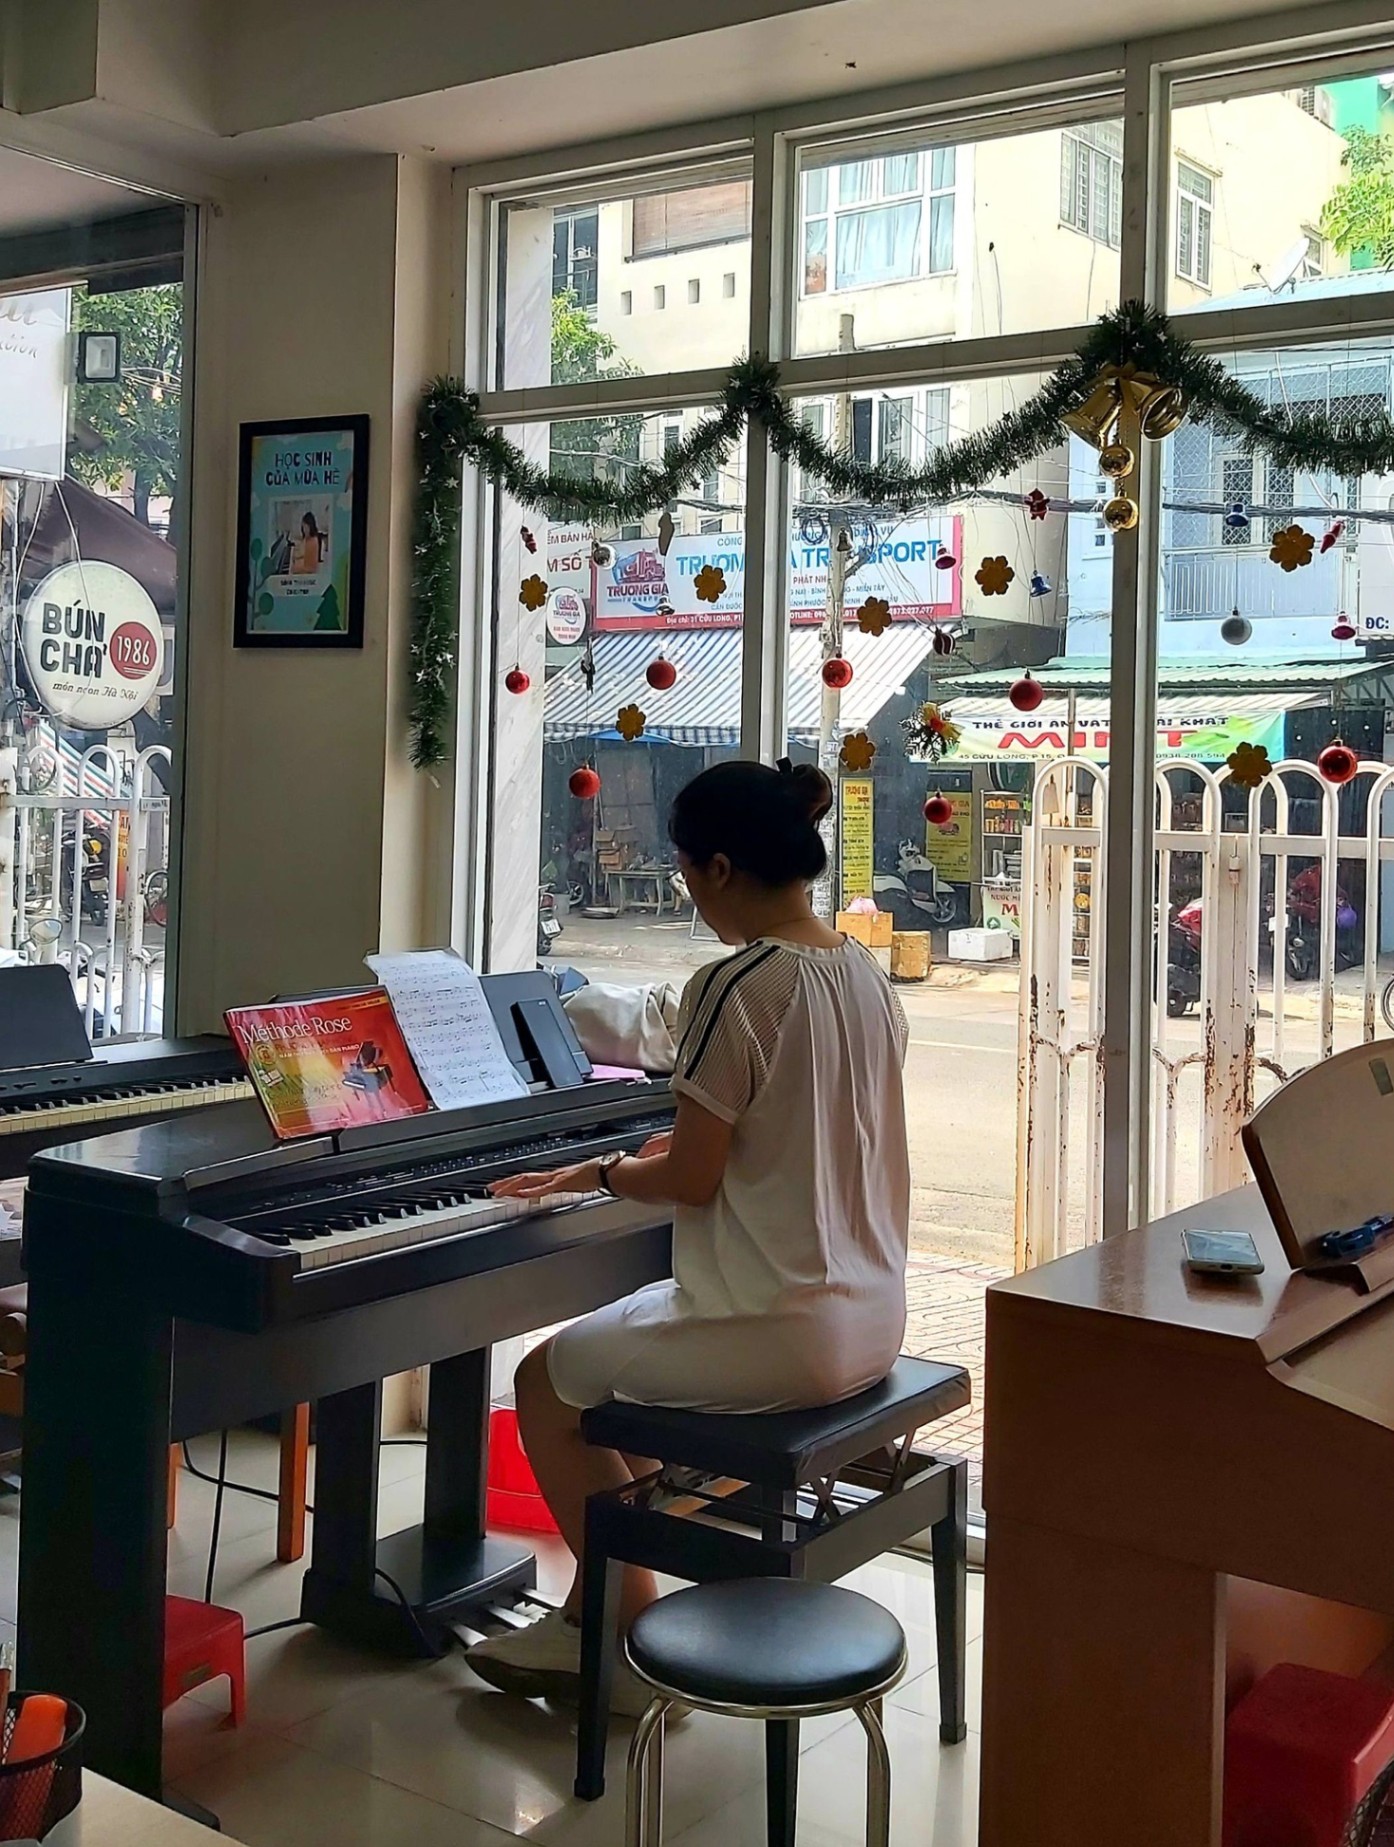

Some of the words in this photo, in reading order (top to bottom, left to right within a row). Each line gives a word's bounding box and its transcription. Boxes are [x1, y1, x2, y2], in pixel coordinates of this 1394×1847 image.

[275, 452, 301, 470] HỌC
[304, 451, 332, 467] SINH
[42, 599, 106, 643] BÚN
[1365, 616, 1389, 630] ĐC:
[40, 638, 108, 679] CHẢ
[117, 635, 150, 666] 1986
[998, 730, 1198, 749] MIT
[312, 1015, 353, 1036] Rose
